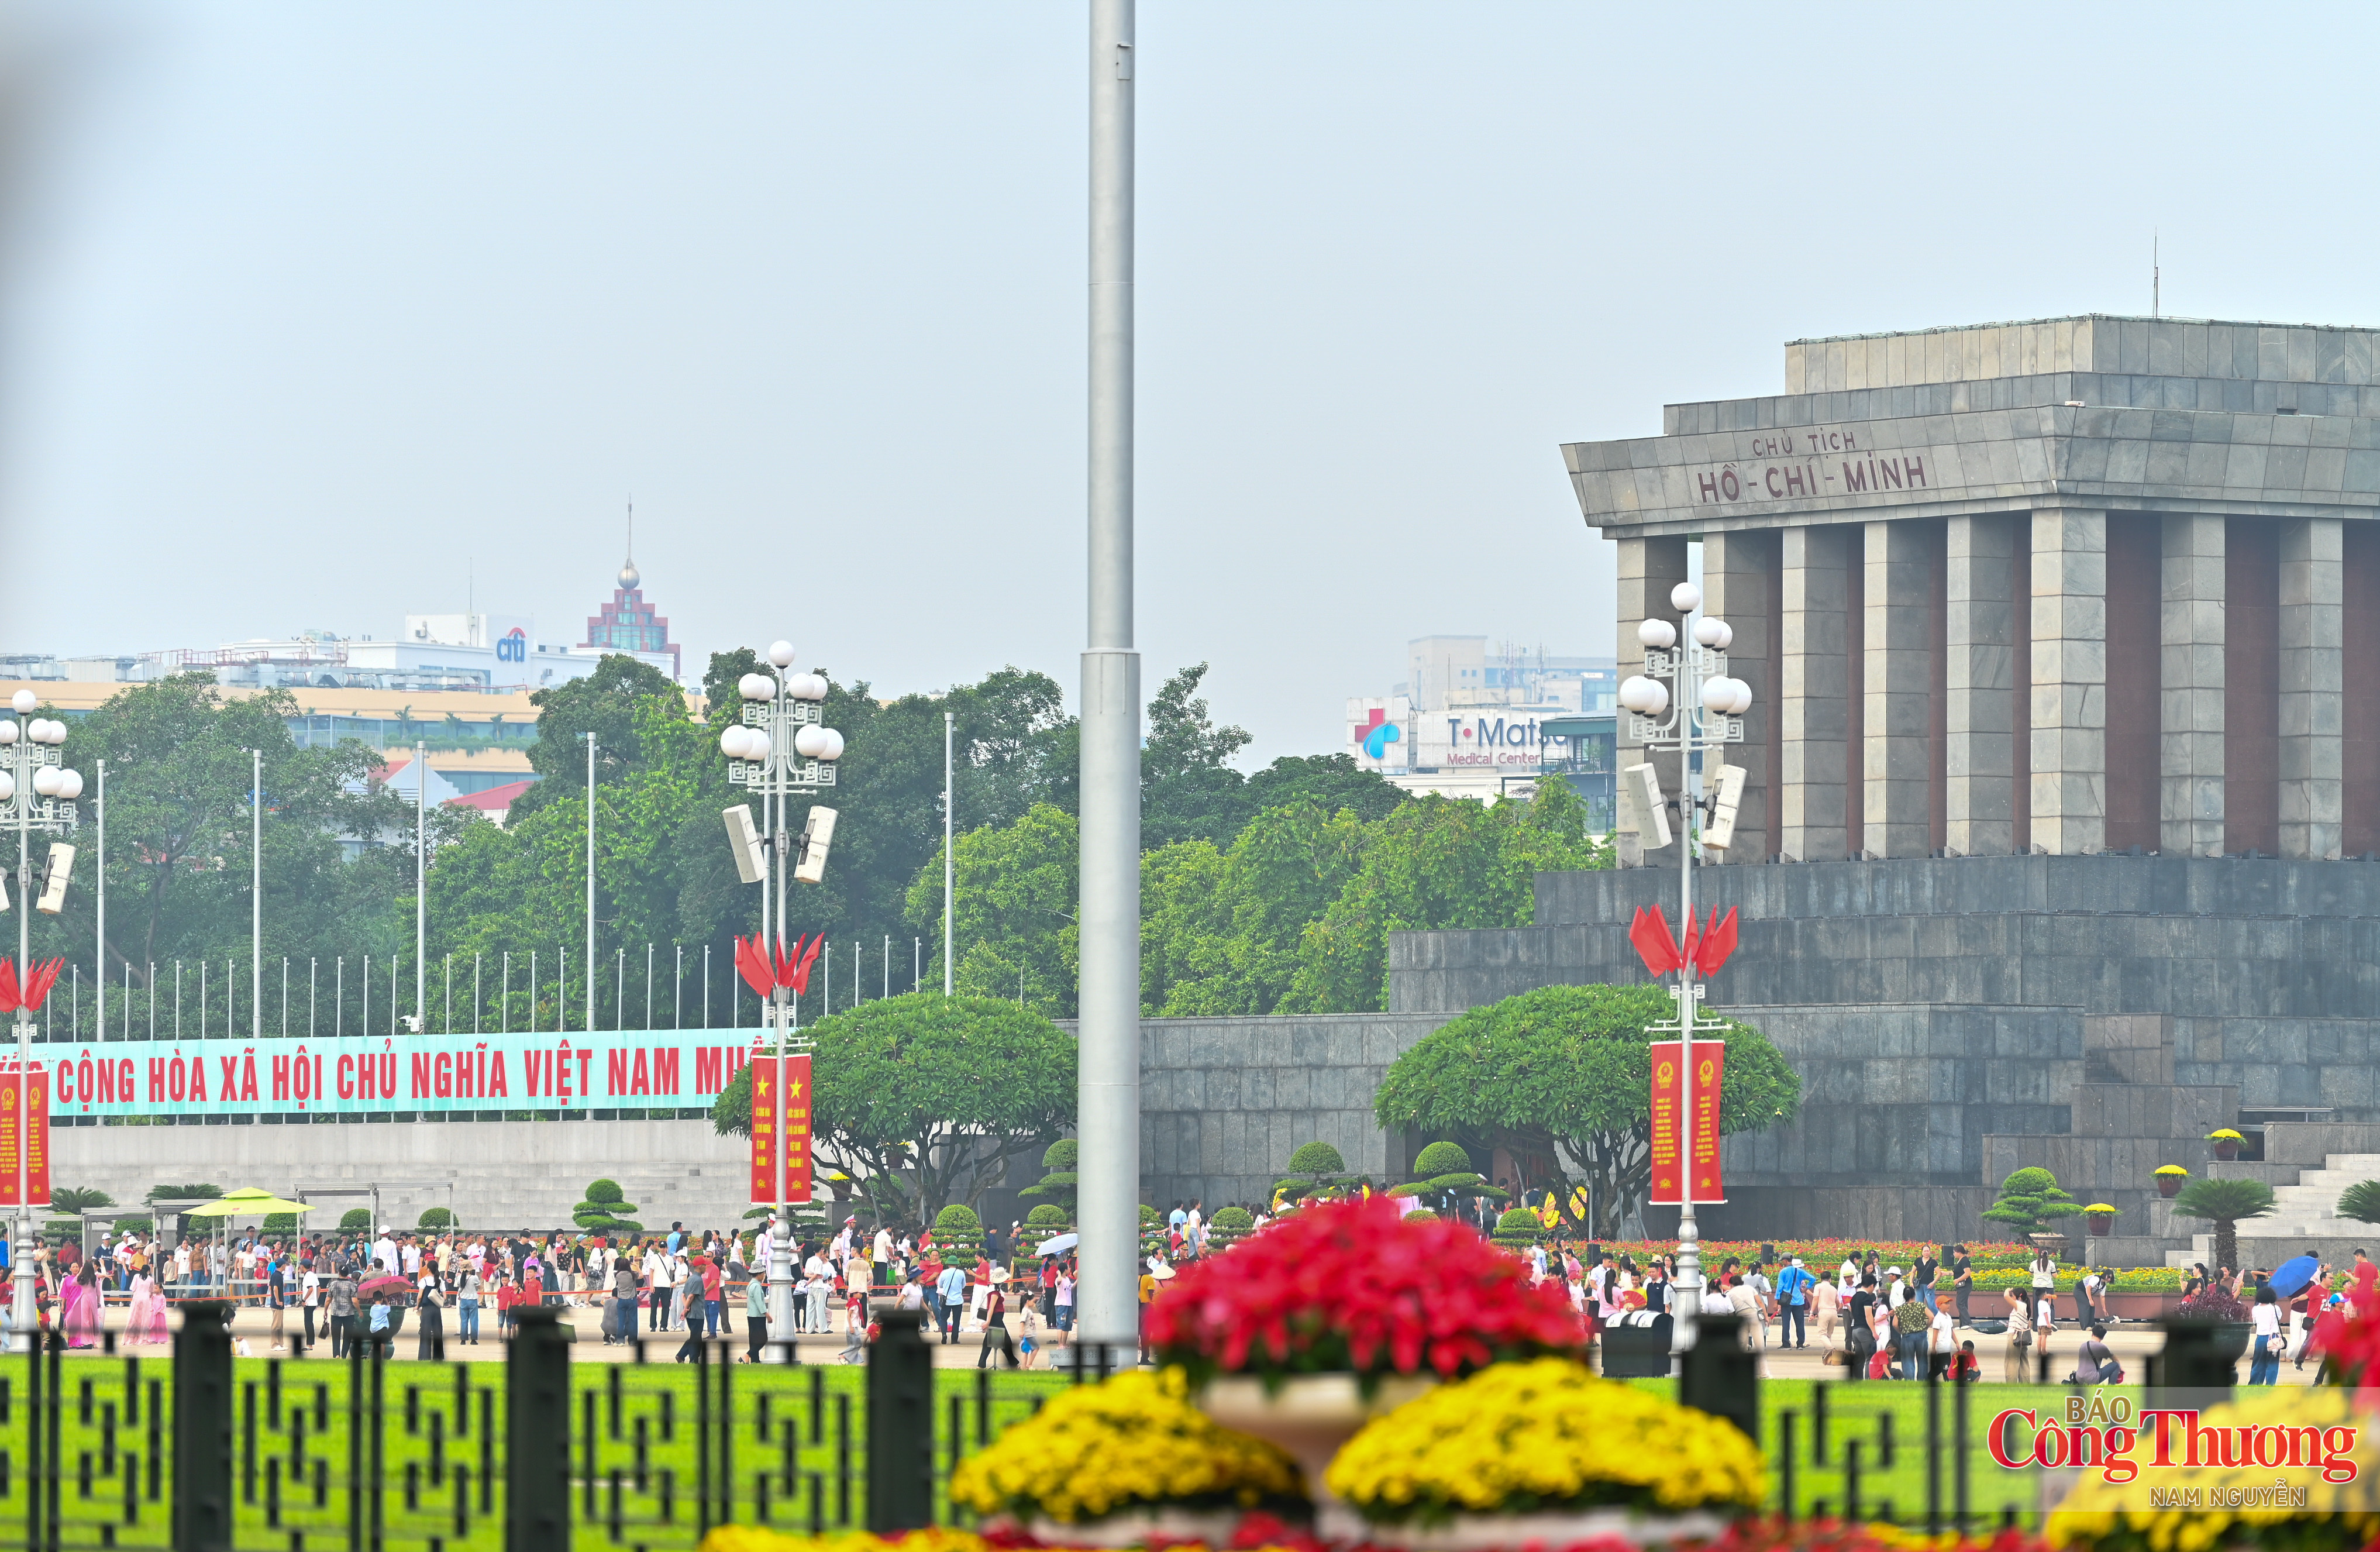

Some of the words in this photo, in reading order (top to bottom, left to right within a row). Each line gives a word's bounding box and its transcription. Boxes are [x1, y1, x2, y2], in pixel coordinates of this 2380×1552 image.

[1765, 457, 1817, 498] CHÍ
[497, 632, 525, 662] citi
[1447, 753, 1492, 765] Medical
[1498, 752, 1541, 764] Center
[58, 1049, 135, 1112] CỘNG
[149, 1048, 207, 1103] HÒA
[221, 1047, 259, 1101] XÃ
[273, 1045, 322, 1110] HỘI
[337, 1038, 397, 1100] CHỦ
[412, 1042, 508, 1099] NGHĨA
[525, 1039, 593, 1106] VIỆT
[608, 1047, 679, 1096] NAM
